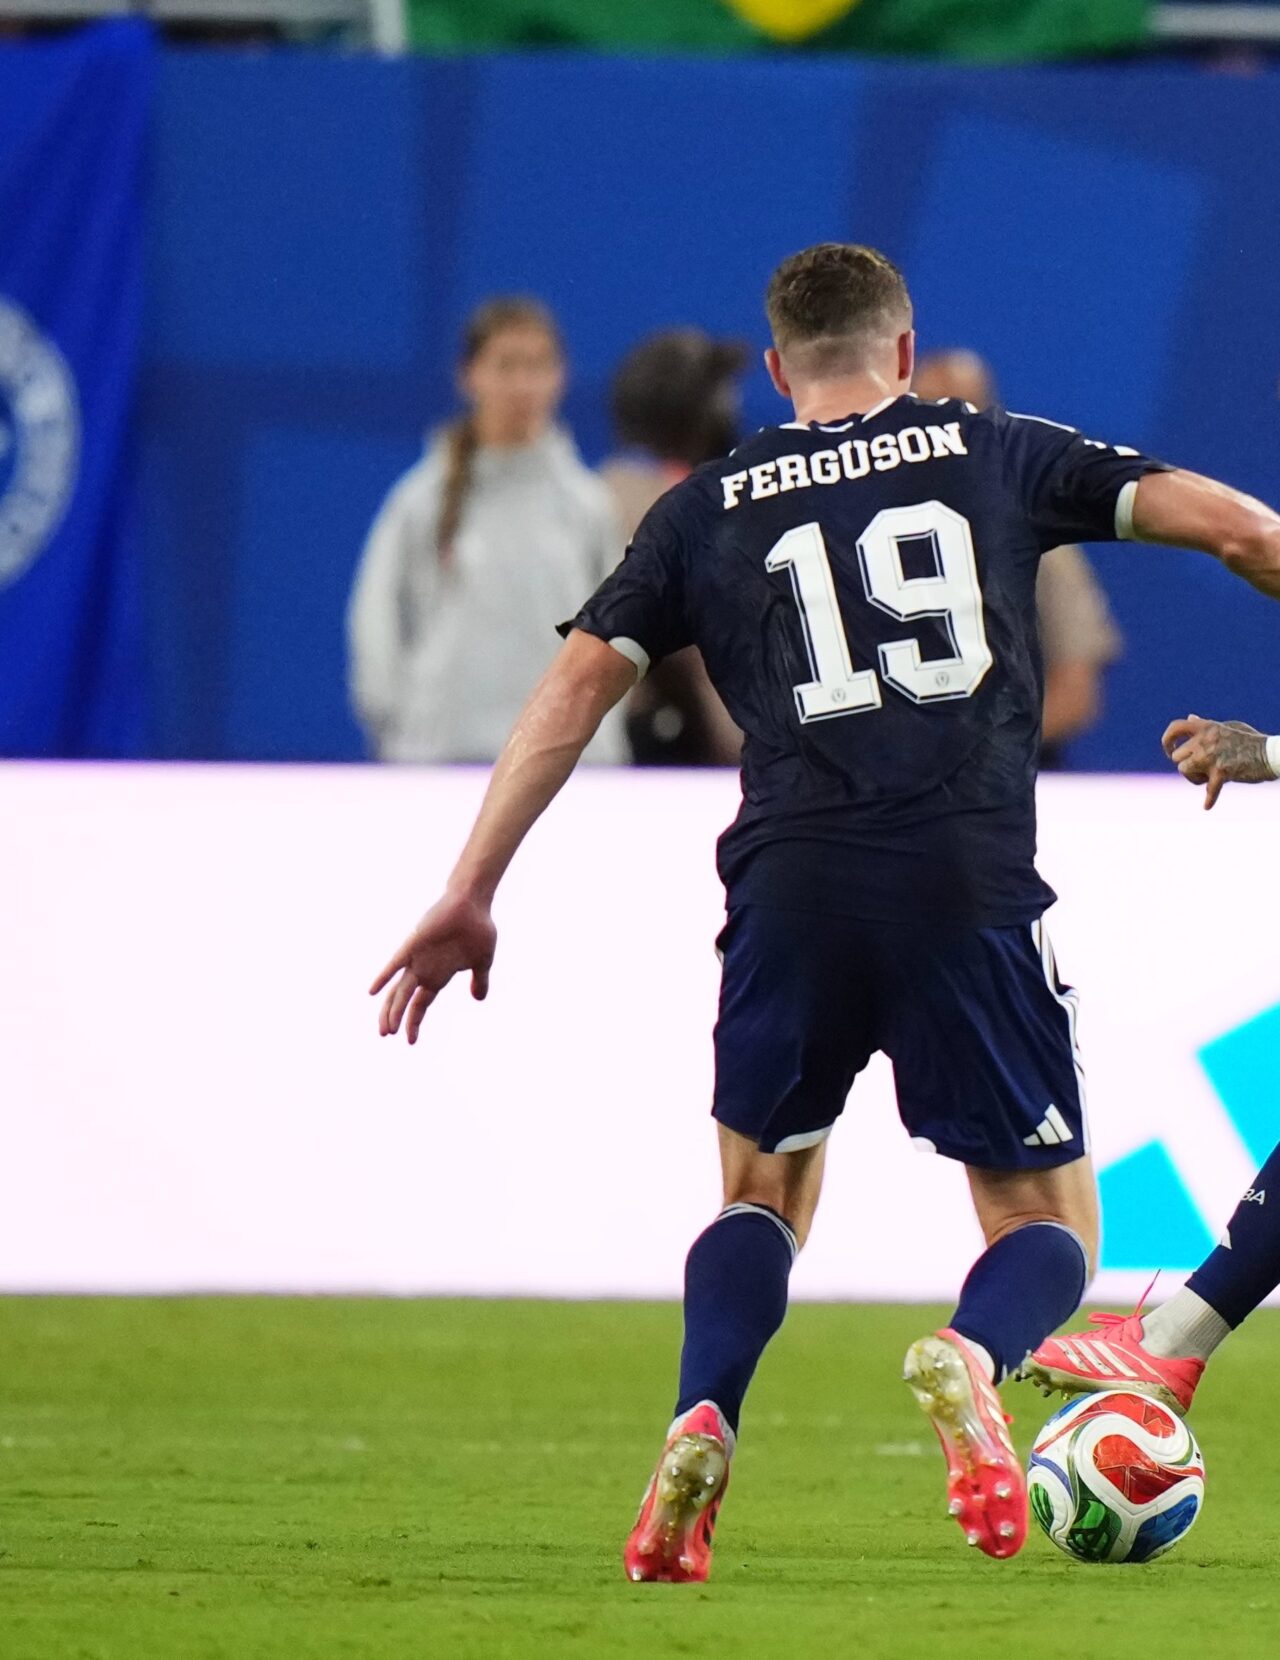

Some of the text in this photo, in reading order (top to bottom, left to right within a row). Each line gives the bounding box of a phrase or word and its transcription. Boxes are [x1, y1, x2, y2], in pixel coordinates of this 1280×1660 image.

[721, 422, 968, 510] FERGUSON
[765, 499, 994, 724] 19
[1241, 1188, 1266, 1206] BA
